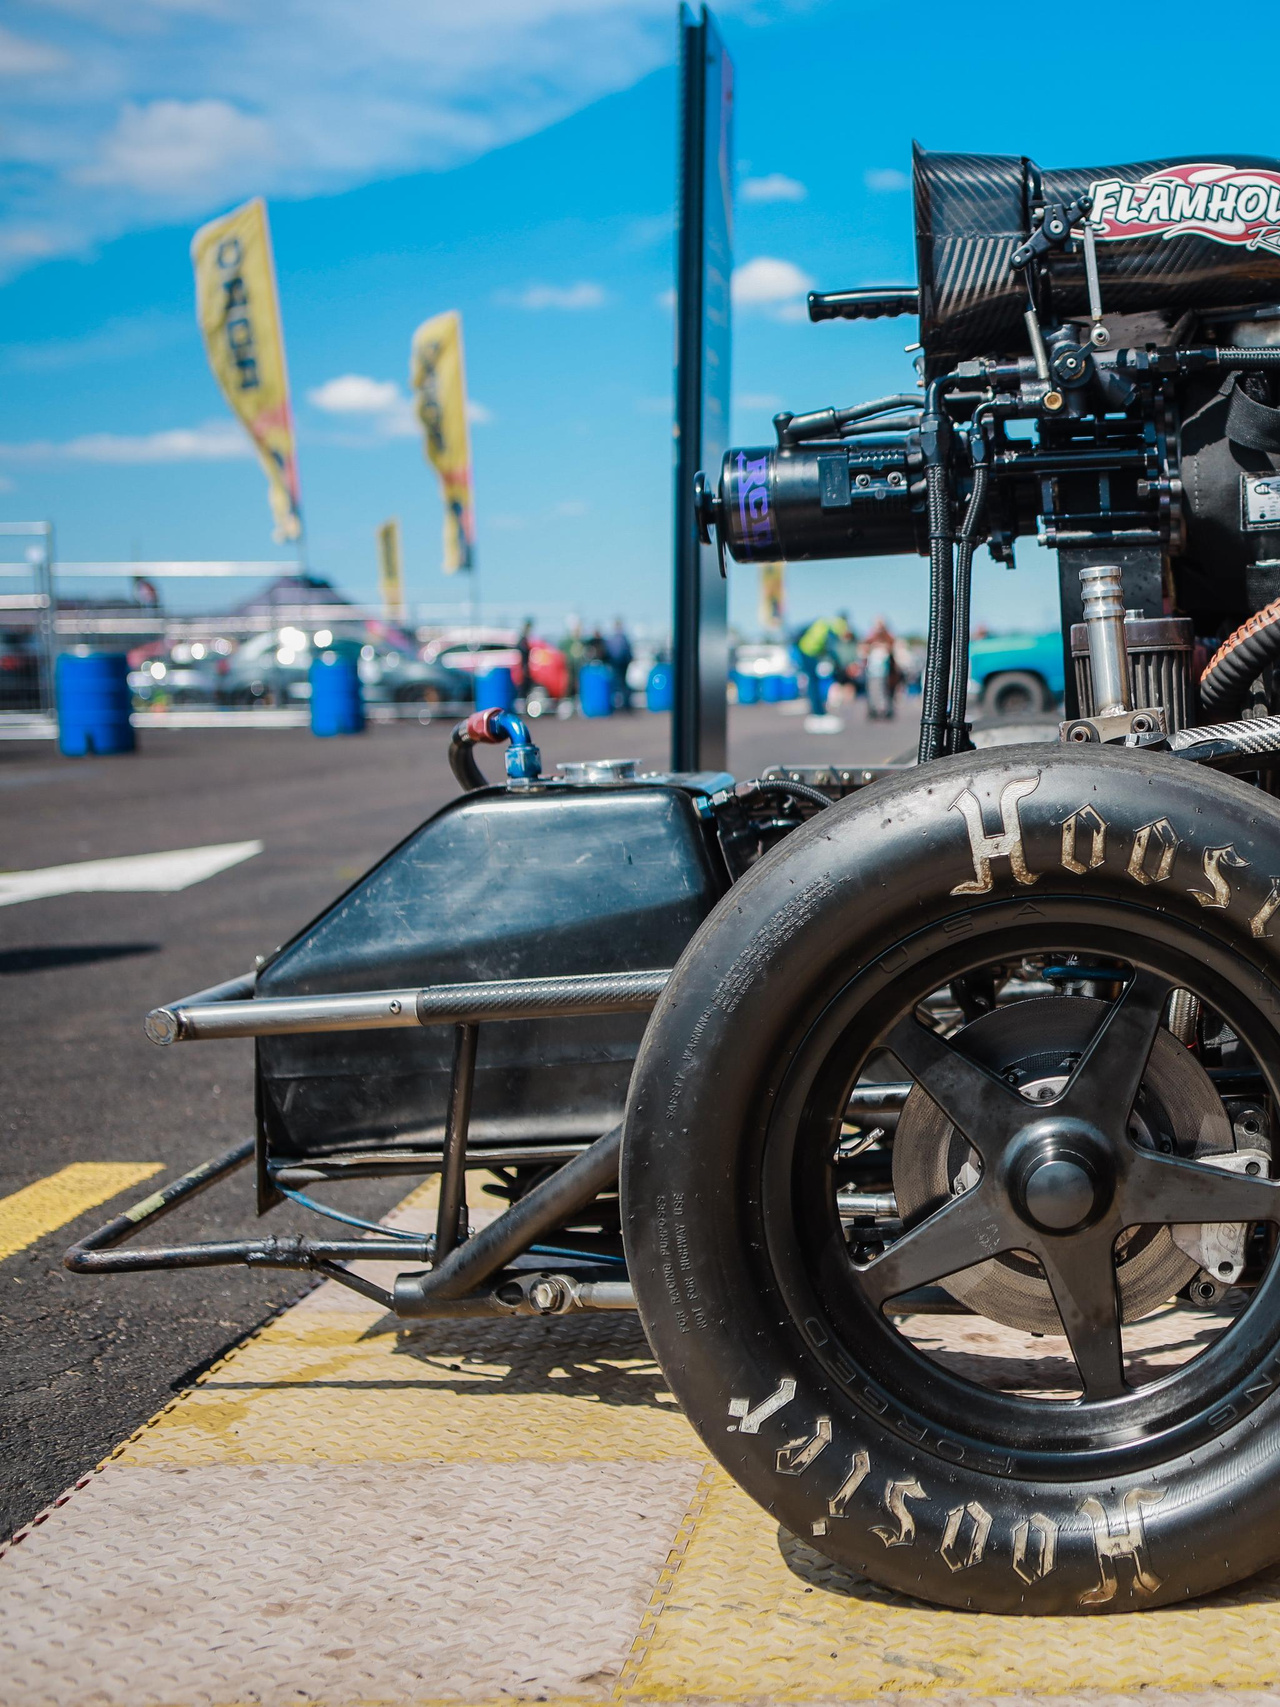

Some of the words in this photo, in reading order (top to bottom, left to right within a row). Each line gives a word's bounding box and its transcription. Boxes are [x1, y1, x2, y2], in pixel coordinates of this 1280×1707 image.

[664, 1070, 686, 1121] SAFETY
[655, 1195, 671, 1257] PURPOSES
[672, 1192, 685, 1216] USE
[673, 1222, 692, 1271] HIGHWAY
[661, 1262, 682, 1306] RACING
[682, 1276, 699, 1301] FOR
[674, 1309, 691, 1335] FOR
[691, 1305, 709, 1330] NOT
[800, 1313, 1011, 1476] FORGED
[726, 1378, 1168, 1606] Hoosier
